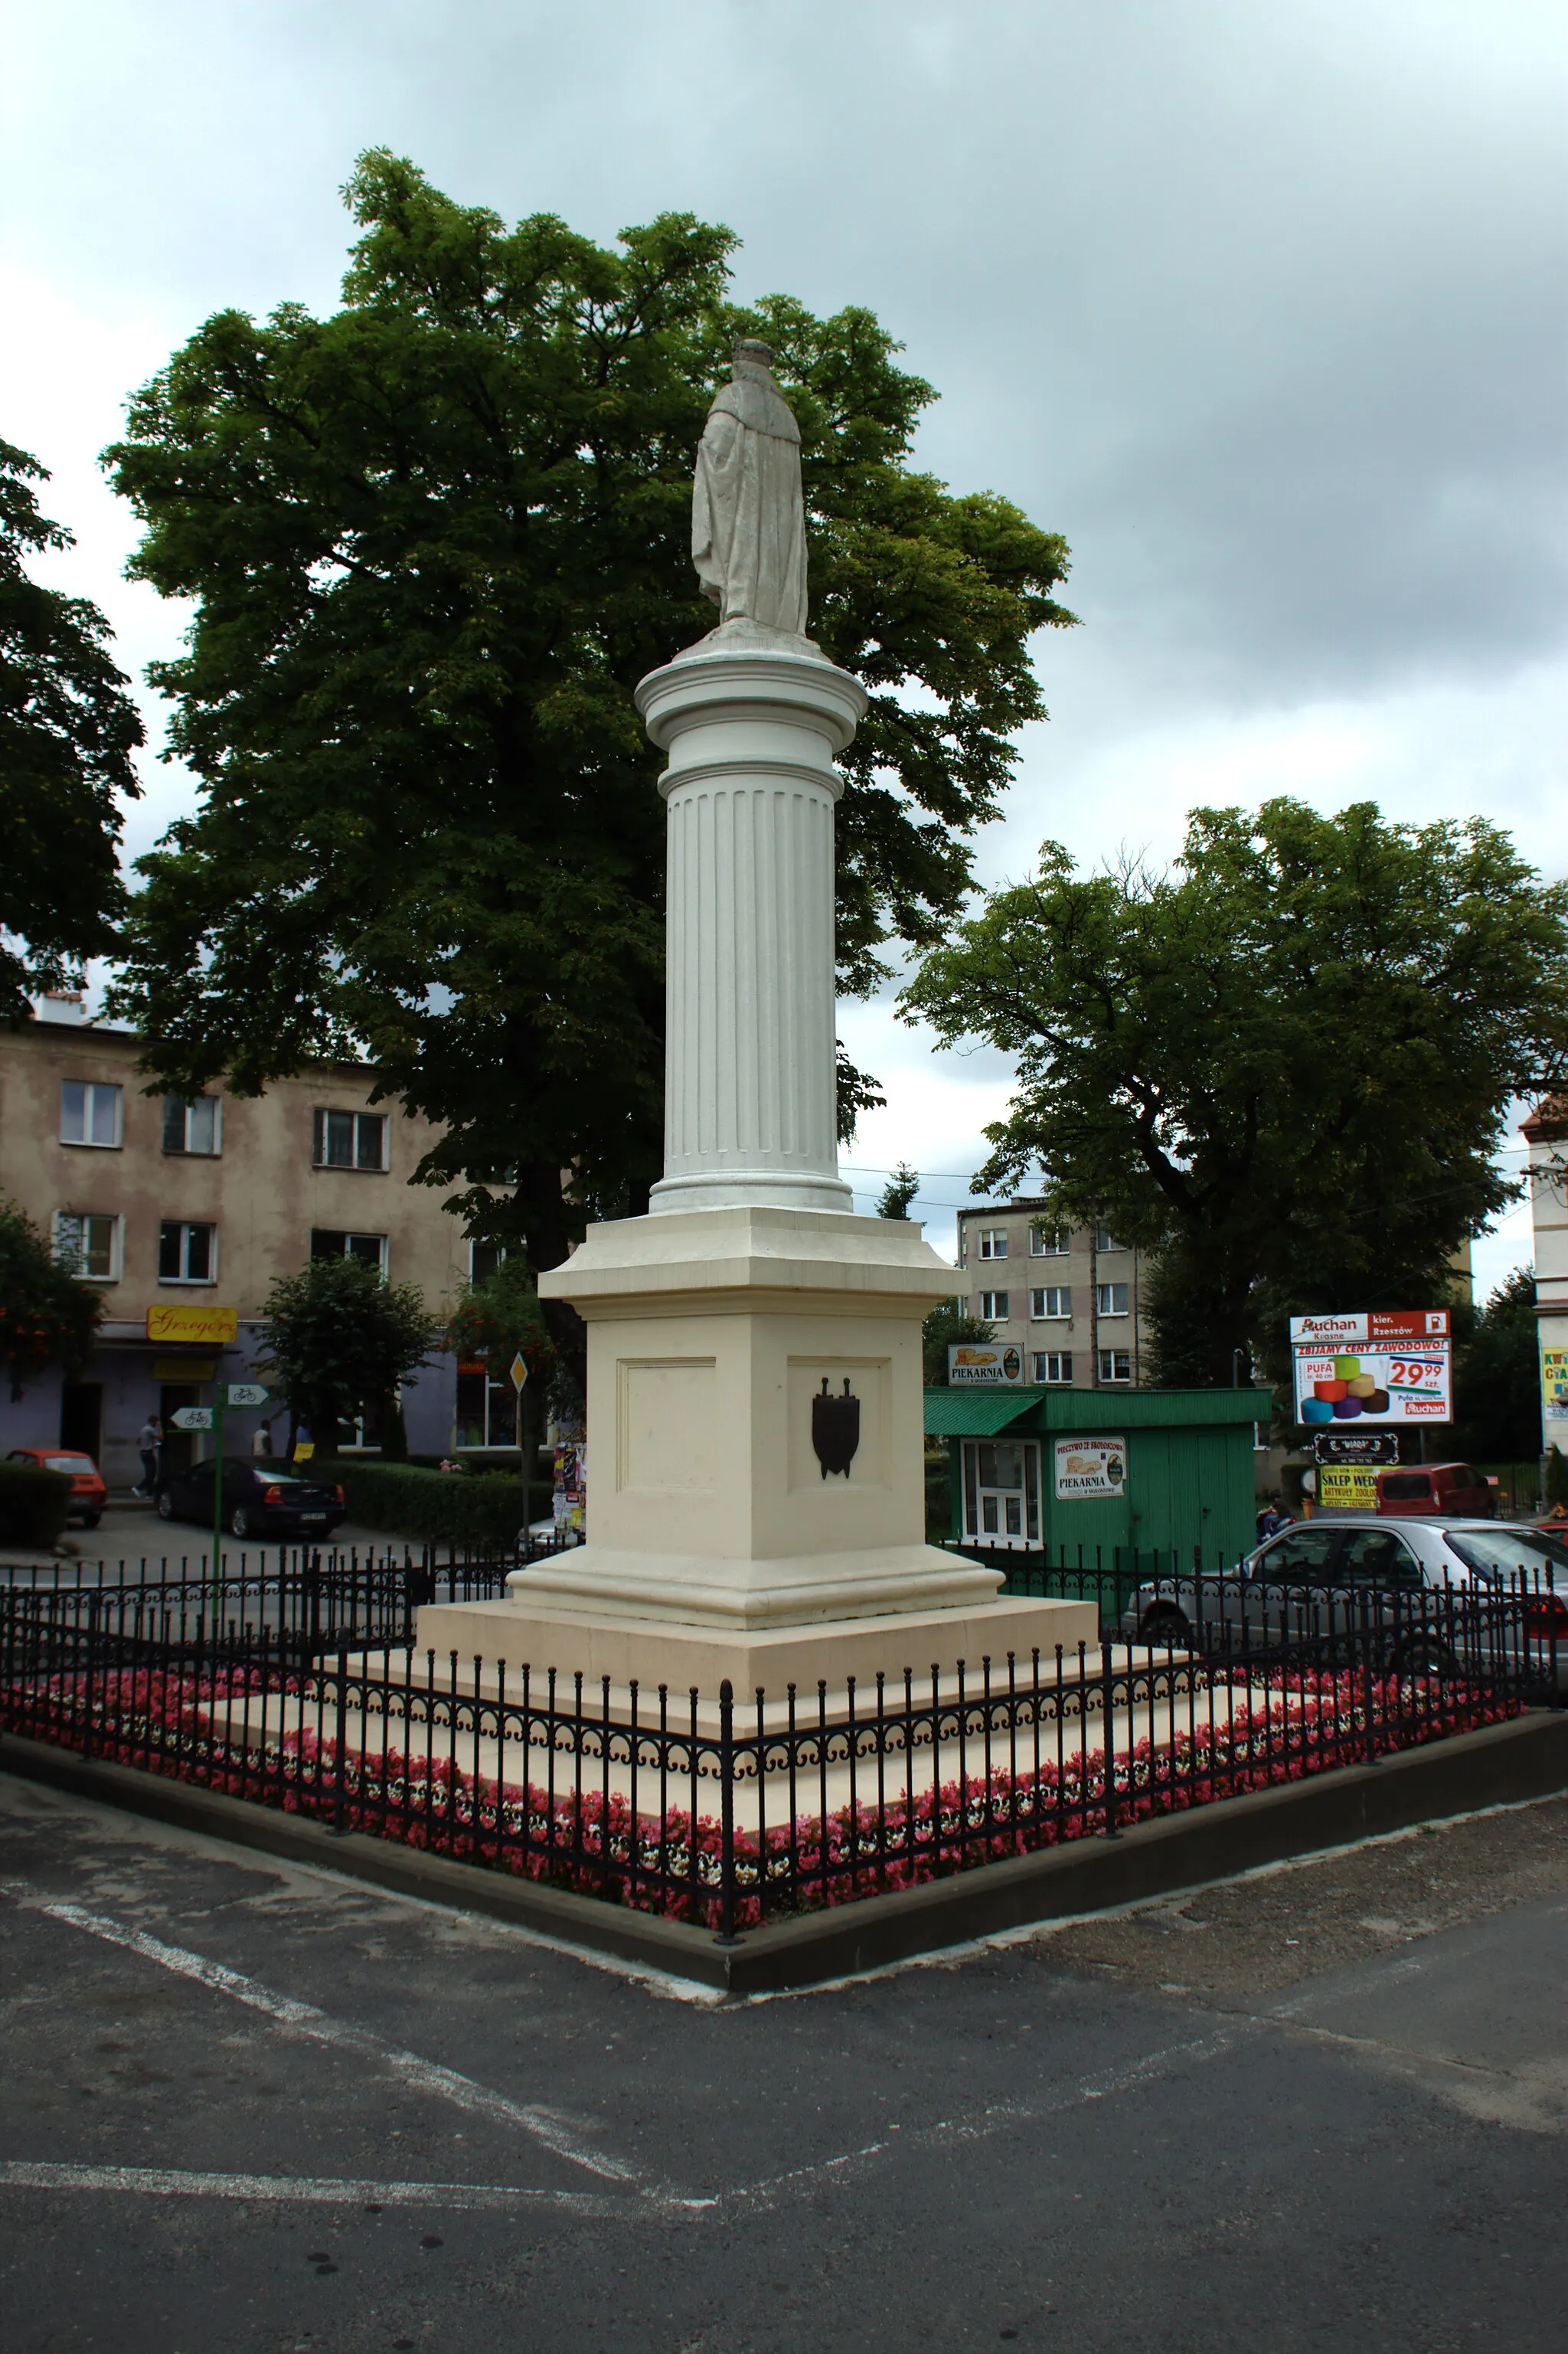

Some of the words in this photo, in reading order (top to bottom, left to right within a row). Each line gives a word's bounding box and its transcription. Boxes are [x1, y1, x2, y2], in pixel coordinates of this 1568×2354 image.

[149, 1308, 234, 1339] Grzegorz
[1302, 1318, 1357, 1332] Auchan
[1373, 1315, 1393, 1324] kier.
[1373, 1326, 1413, 1336] Rzeszów
[1298, 1345, 1341, 1355] ZBIJAMY
[1345, 1344, 1371, 1354] CENY
[1375, 1340, 1445, 1352] ZAWODOWO!
[952, 1368, 1004, 1378] PIEKARNIA
[1307, 1364, 1332, 1372] PUFA
[1406, 1403, 1445, 1414] Auchan
[1057, 1442, 1083, 1454] PIECZYWO
[1083, 1441, 1089, 1450] ZE
[1060, 1476, 1106, 1488] PIEKARNIA
[1322, 1475, 1351, 1486] SKLEP
[1324, 1487, 1352, 1497] ARTYKUŁY
